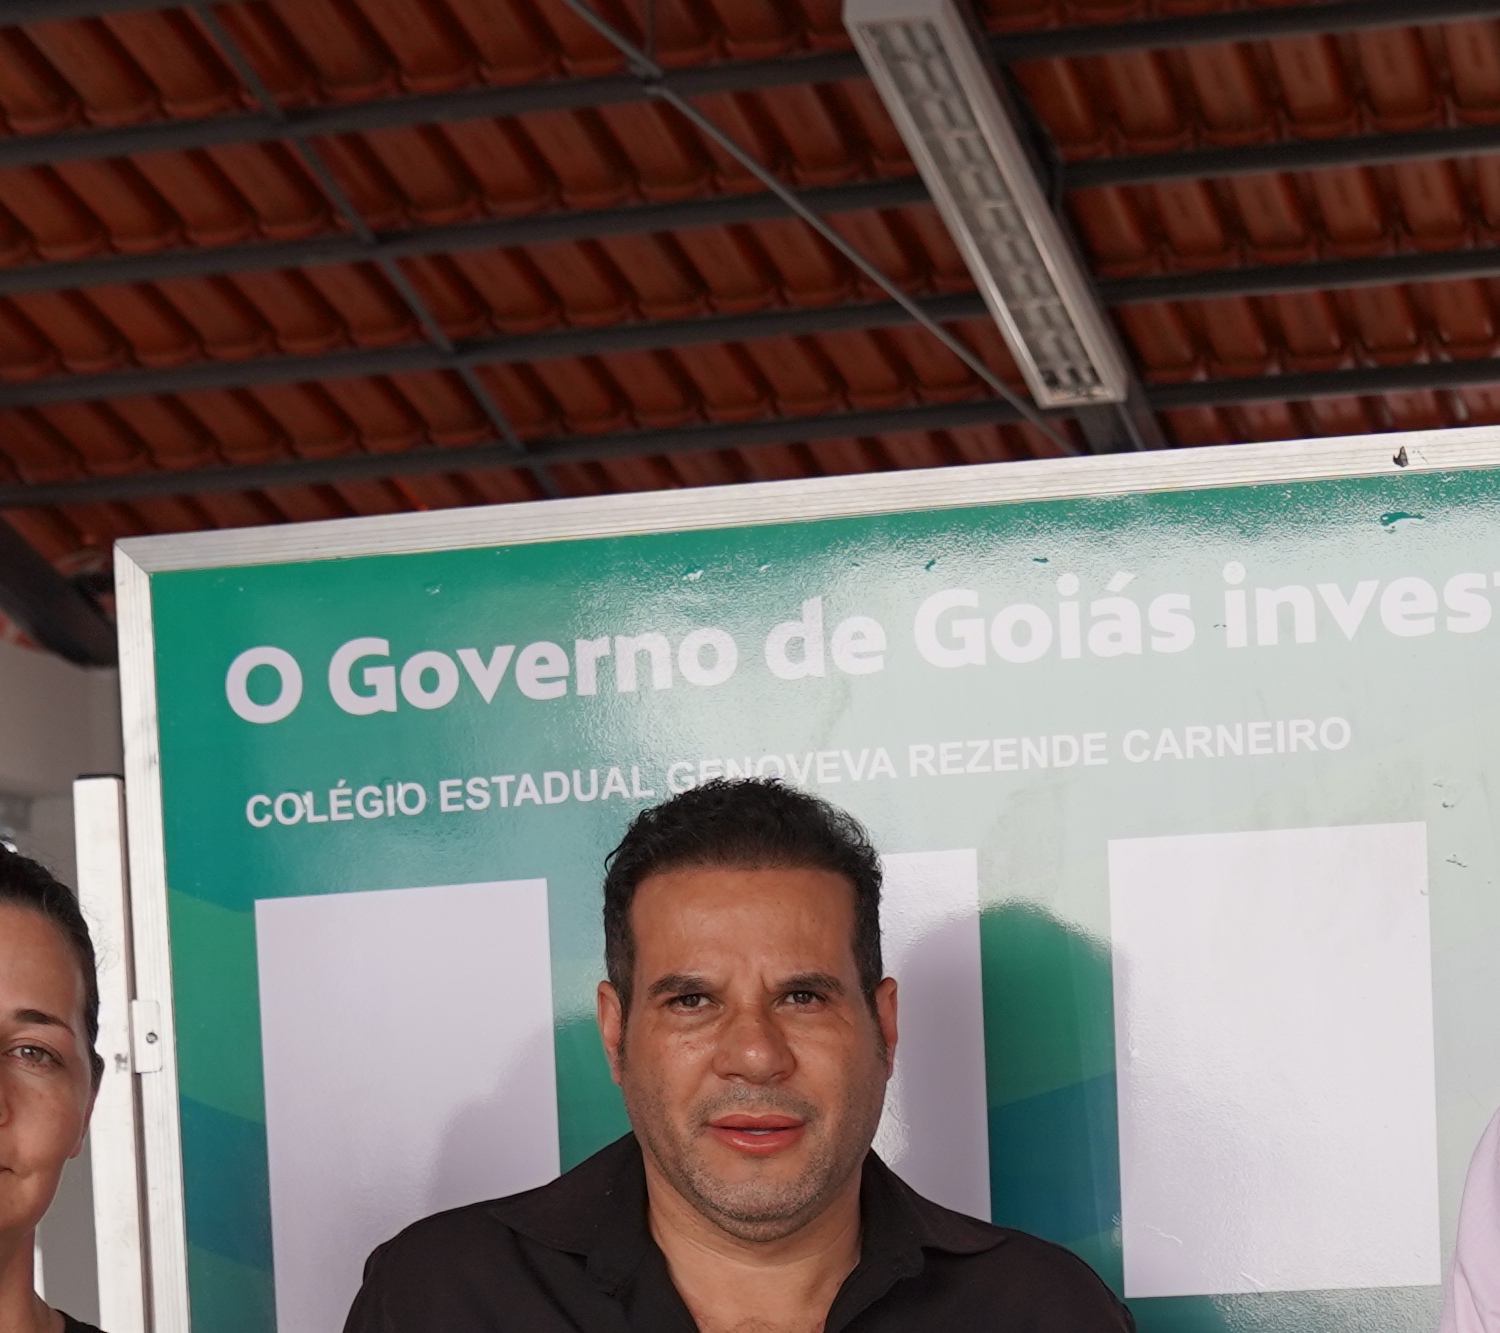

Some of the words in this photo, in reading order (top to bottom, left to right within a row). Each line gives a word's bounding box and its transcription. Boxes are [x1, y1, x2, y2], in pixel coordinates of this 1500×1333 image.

[225, 645, 304, 725] O
[329, 627, 735, 716] Governo
[765, 596, 886, 680] de
[914, 575, 1196, 669] Goiás
[245, 779, 427, 829] COLÉGIO
[440, 766, 654, 813] ESTADUAL
[666, 747, 898, 795] GENOVEVA
[909, 729, 1108, 779] REZENDE
[1123, 716, 1351, 760] CARNEIRO
